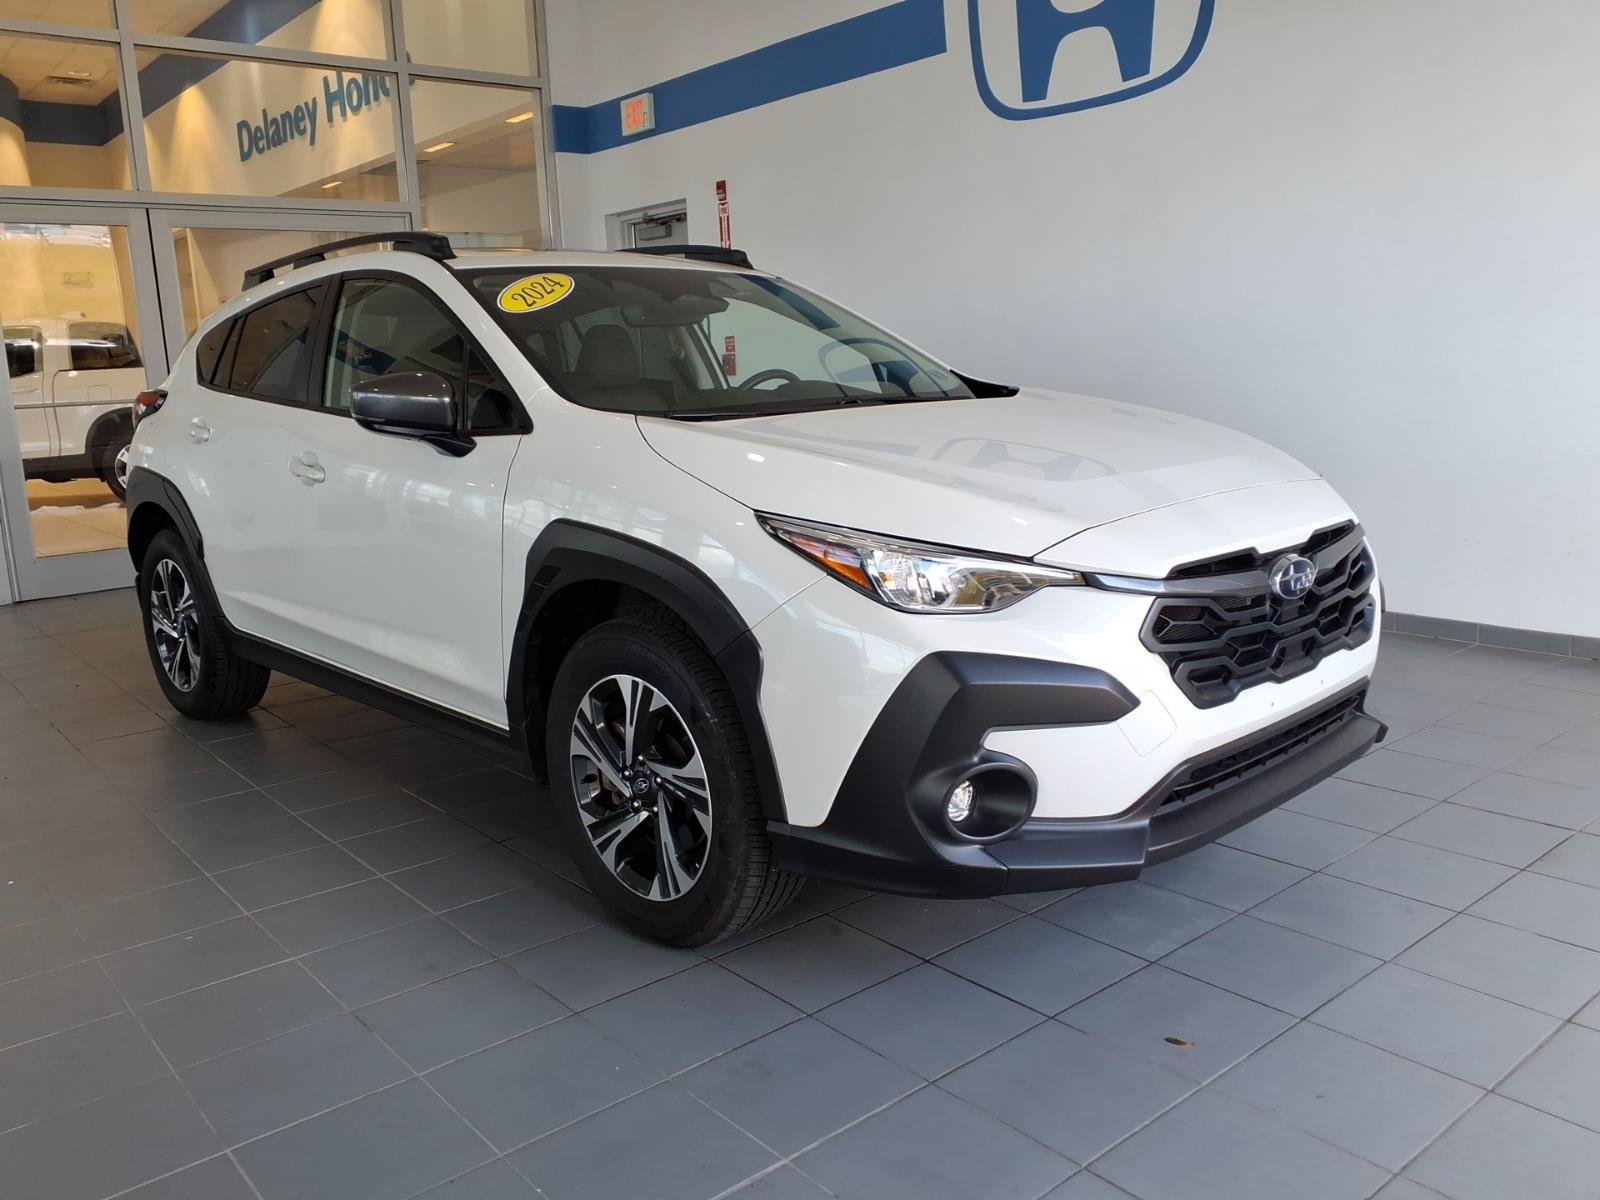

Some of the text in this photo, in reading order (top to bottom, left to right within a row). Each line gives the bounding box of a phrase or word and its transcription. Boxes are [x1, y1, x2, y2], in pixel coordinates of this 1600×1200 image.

[236, 64, 402, 162] Delaney Hon
[511, 276, 565, 308] 2024
